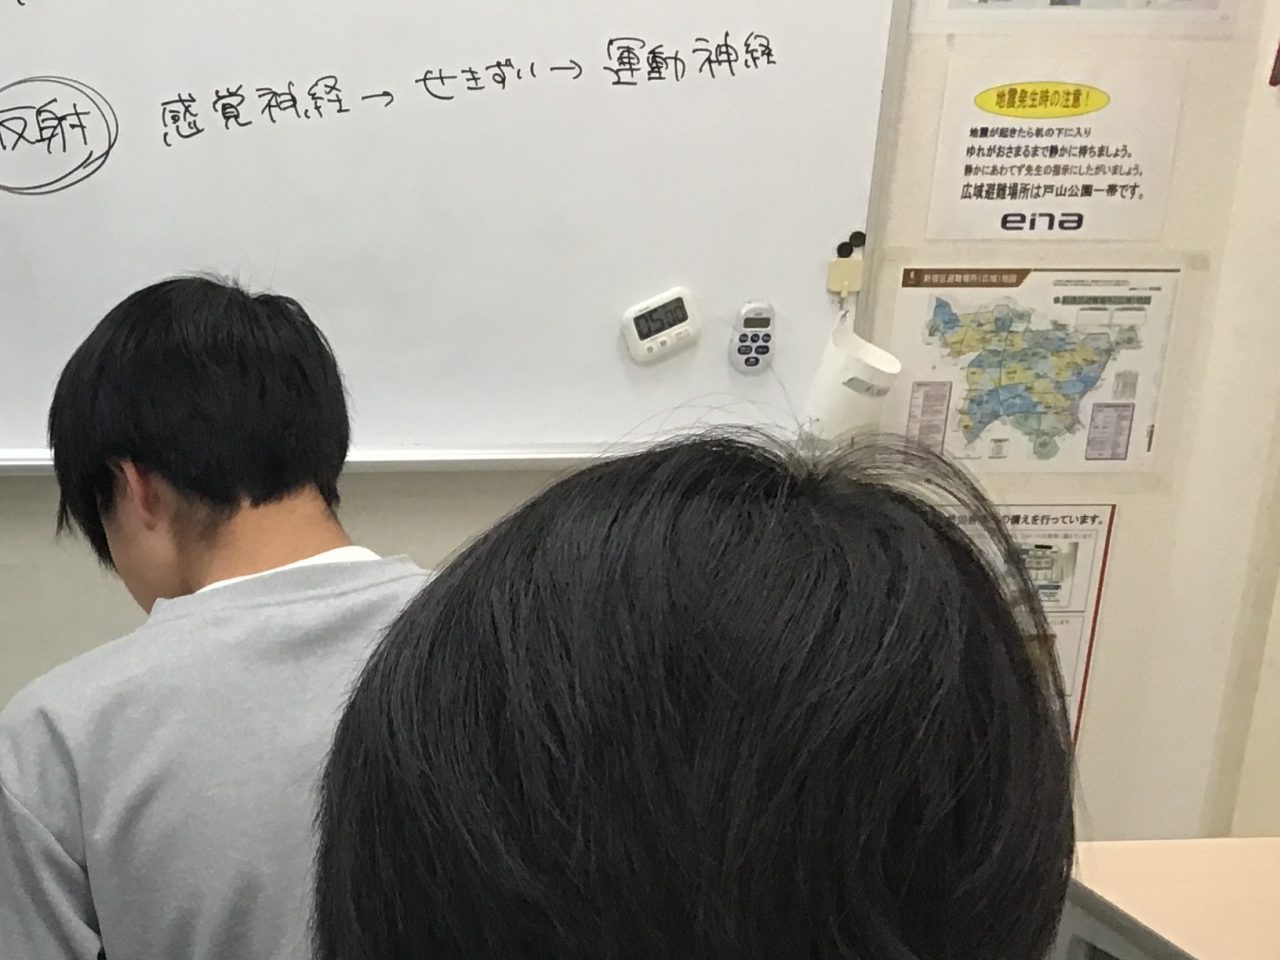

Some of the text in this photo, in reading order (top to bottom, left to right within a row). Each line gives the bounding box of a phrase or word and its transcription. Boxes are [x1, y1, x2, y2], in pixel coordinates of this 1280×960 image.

[160, 32, 777, 147] 感覚神経 せきずい 運動神経
[969, 127, 1092, 138] 地震が起きたら机の下に入り
